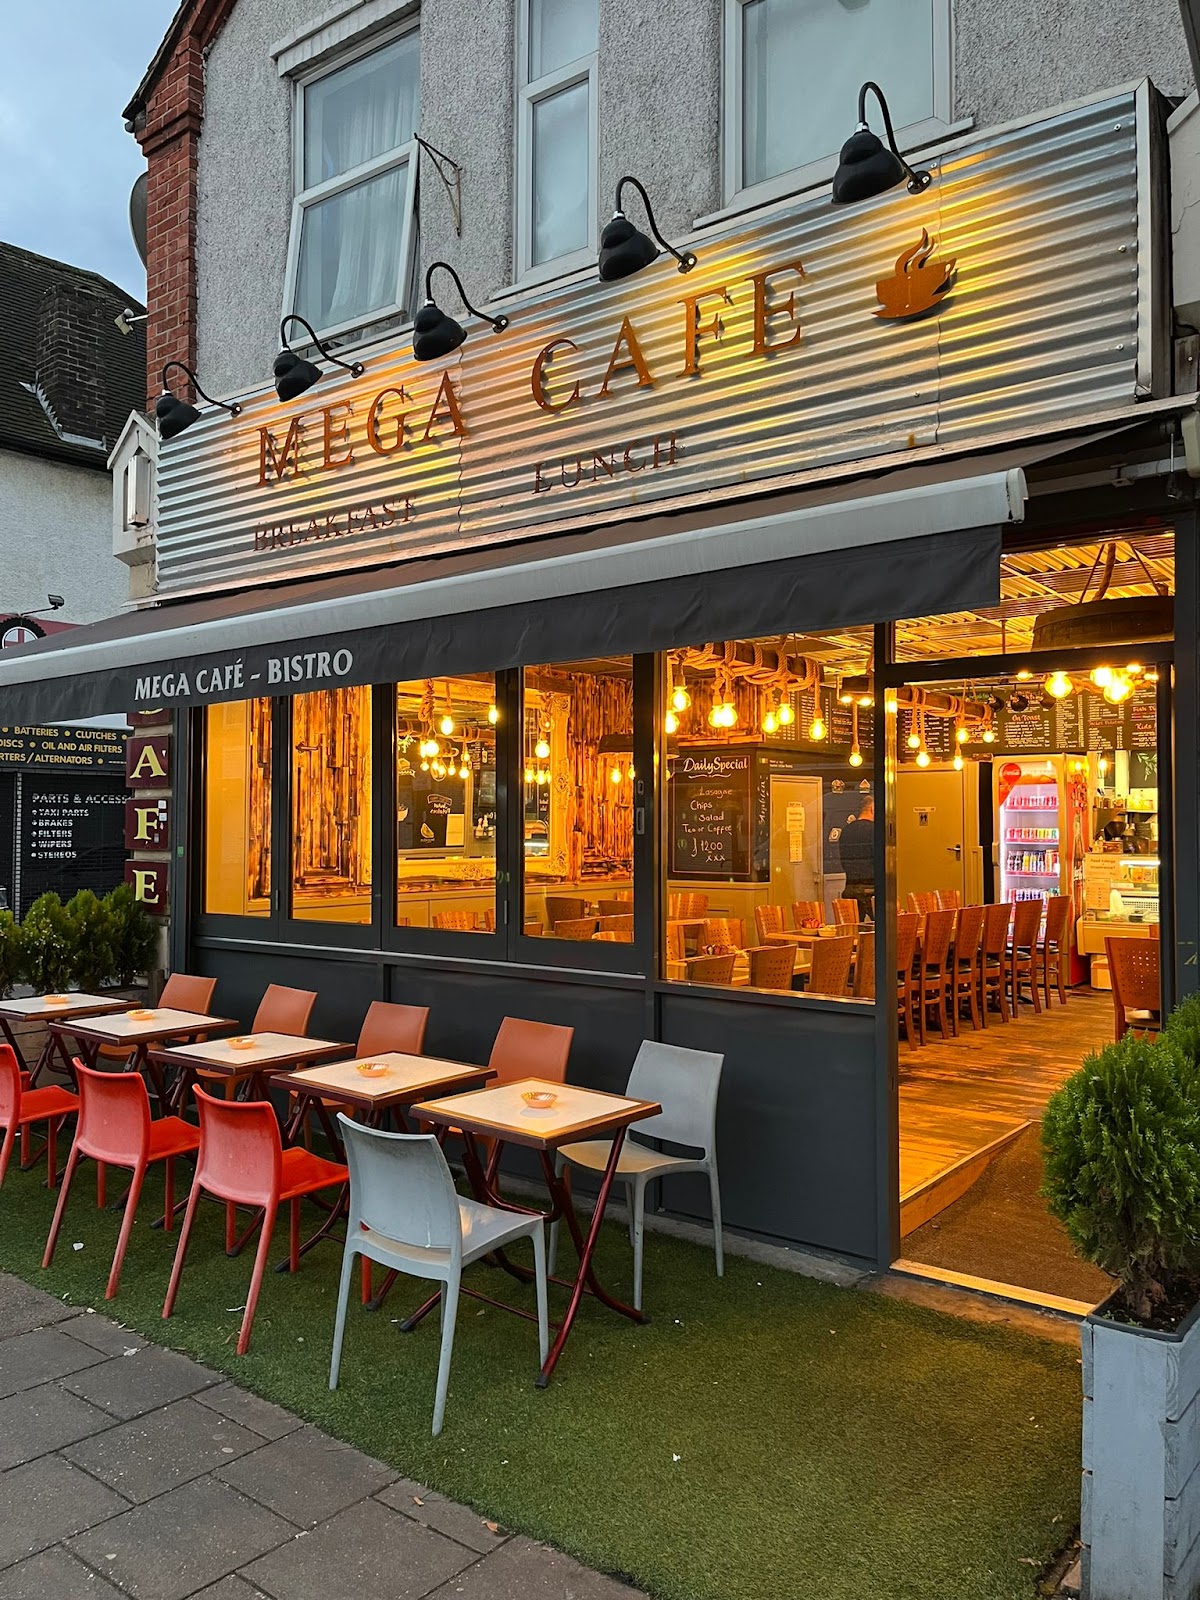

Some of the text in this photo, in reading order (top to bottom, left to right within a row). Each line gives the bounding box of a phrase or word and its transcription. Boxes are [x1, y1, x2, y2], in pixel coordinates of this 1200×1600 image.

[256, 261, 807, 488] MEGA CAFE
[532, 431, 679, 494] LUNCH
[252, 495, 417, 552] BREAKFAST
[134, 672, 190, 700] MEGA
[195, 658, 245, 694] CAFÉ
[267, 648, 353, 685] BISTRO
[14, 726, 117, 741] BATTERIES CLUTCHES
[41, 741, 56, 750] OIL
[57, 741, 77, 751] AND
[78, 743, 93, 752] AIR
[93, 744, 123, 754] FILTERS
[34, 754, 93, 765] ALTERNATORS
[683, 756, 748, 774] Daily Special
[699, 786, 733, 799] Lasagne
[32, 793, 69, 804] PARTS
[85, 794, 131, 804] ACCESS
[690, 800, 713, 811] Chips
[38, 809, 90, 817] TAXI PARTS
[698, 811, 725, 821] Salad
[38, 819, 74, 827] BRAKES
[38, 830, 73, 838] FILTERS
[38, 840, 72, 848] WIPERS
[37, 851, 77, 859] STEREOS
